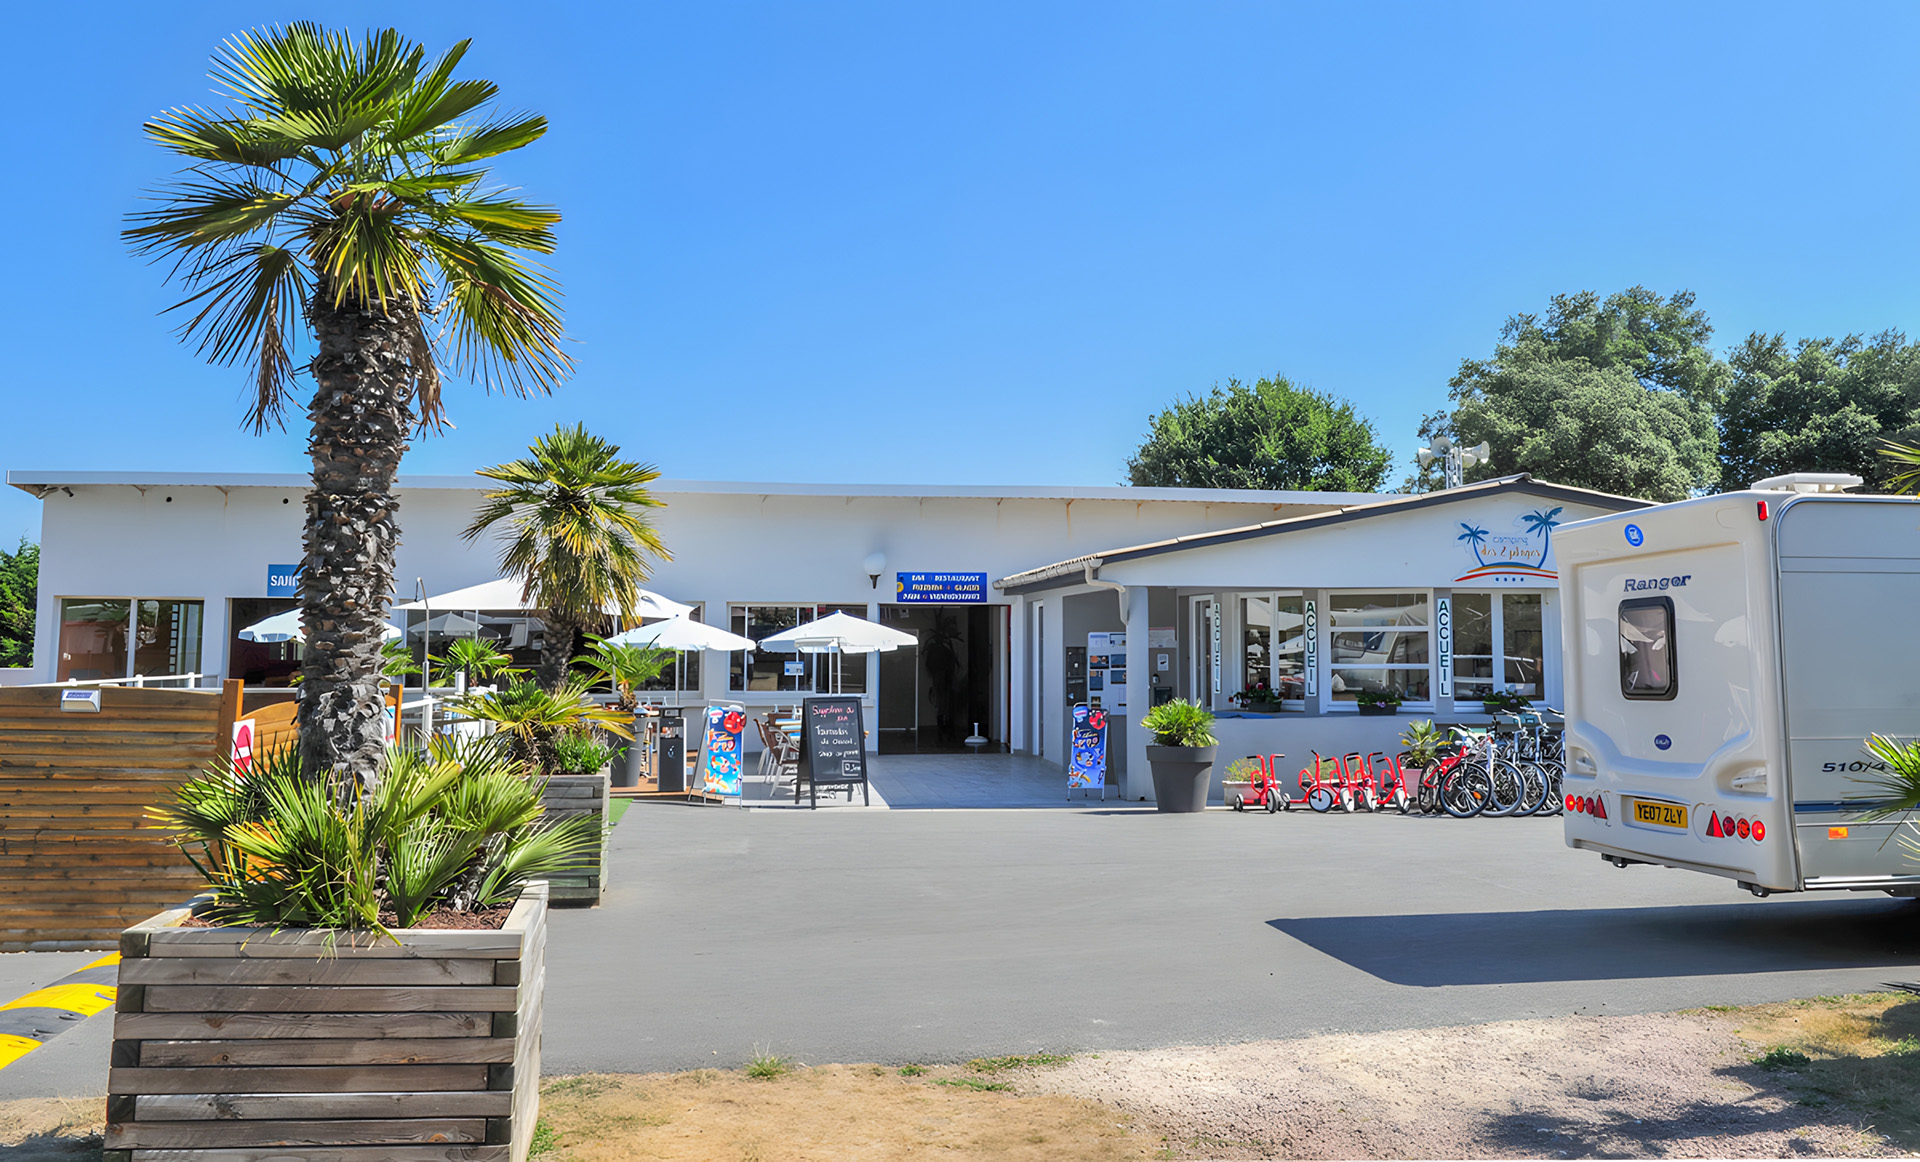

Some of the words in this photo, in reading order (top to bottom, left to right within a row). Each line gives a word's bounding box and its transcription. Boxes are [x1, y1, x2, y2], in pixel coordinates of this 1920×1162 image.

[1623, 575, 1692, 592] Ranger
[1306, 601, 1316, 695] ACCUEIL
[1439, 600, 1450, 696] ACCUEIL
[1637, 804, 1661, 822] YE07
[1664, 807, 1683, 824] ZLY
